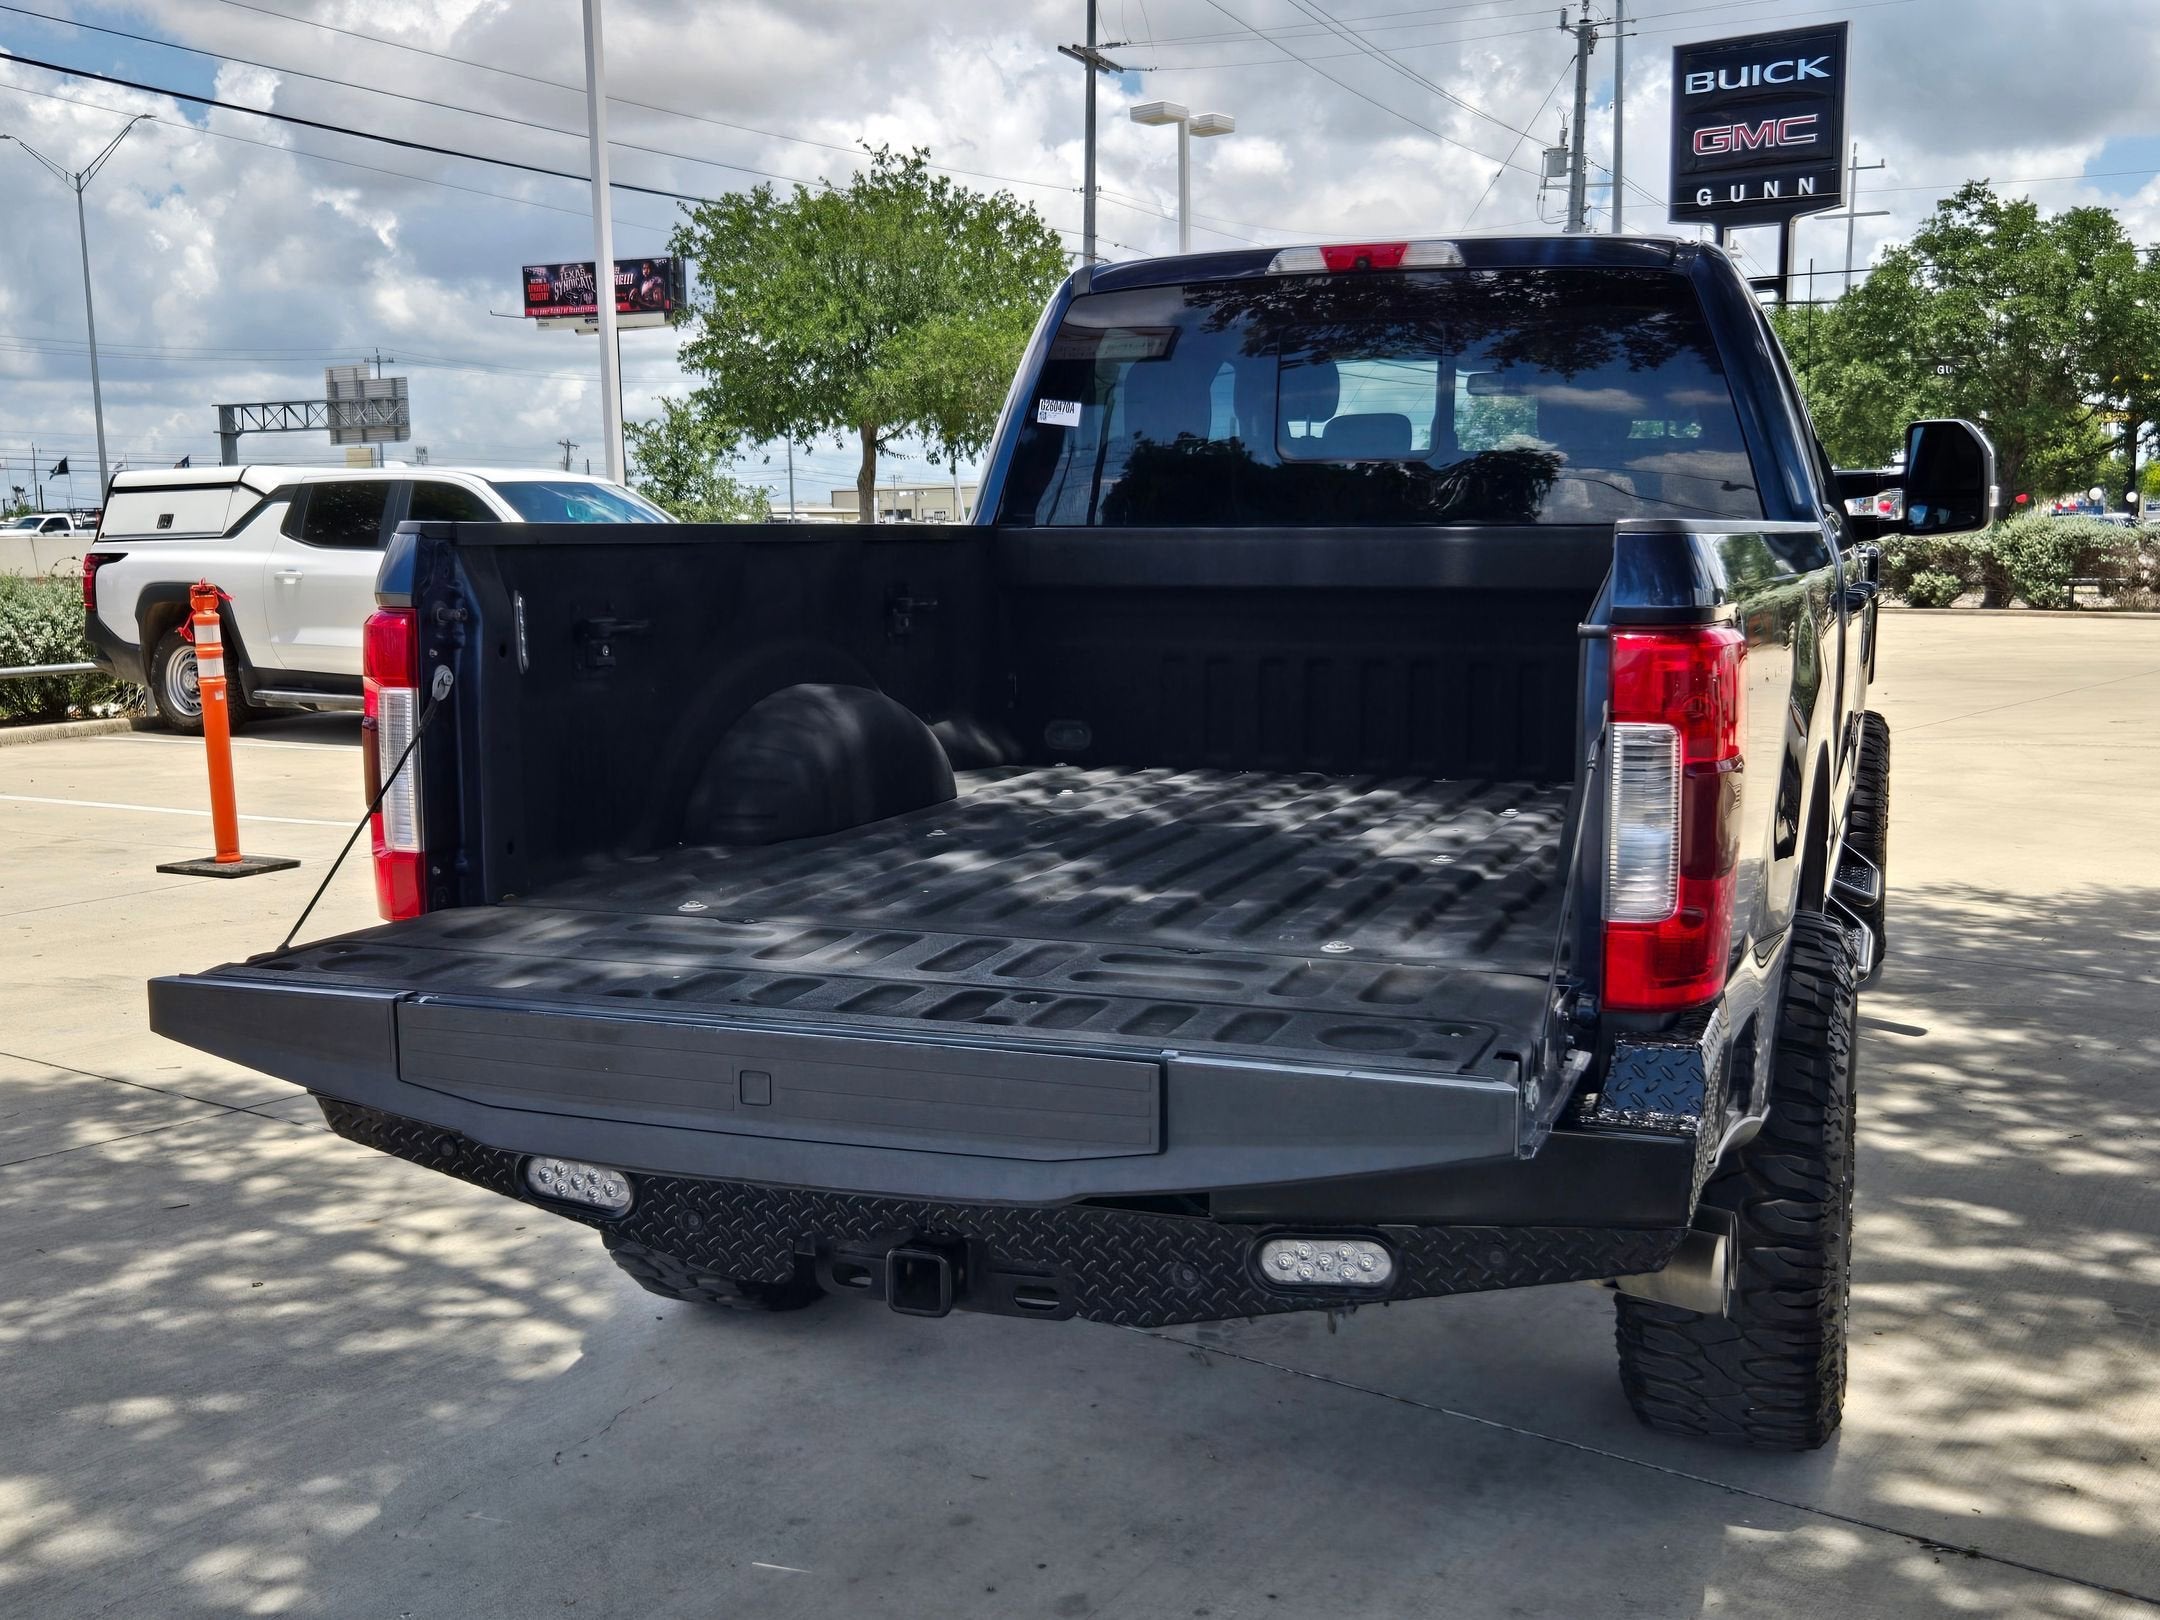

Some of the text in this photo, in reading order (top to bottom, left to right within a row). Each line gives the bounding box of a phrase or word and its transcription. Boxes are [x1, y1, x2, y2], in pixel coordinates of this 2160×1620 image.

[1685, 55, 1831, 95] BUICK
[1693, 113, 1819, 156] GMC
[1696, 176, 1814, 207] GUNN
[554, 274, 597, 302] SYNDICATE
[560, 268, 586, 283] TEXAS
